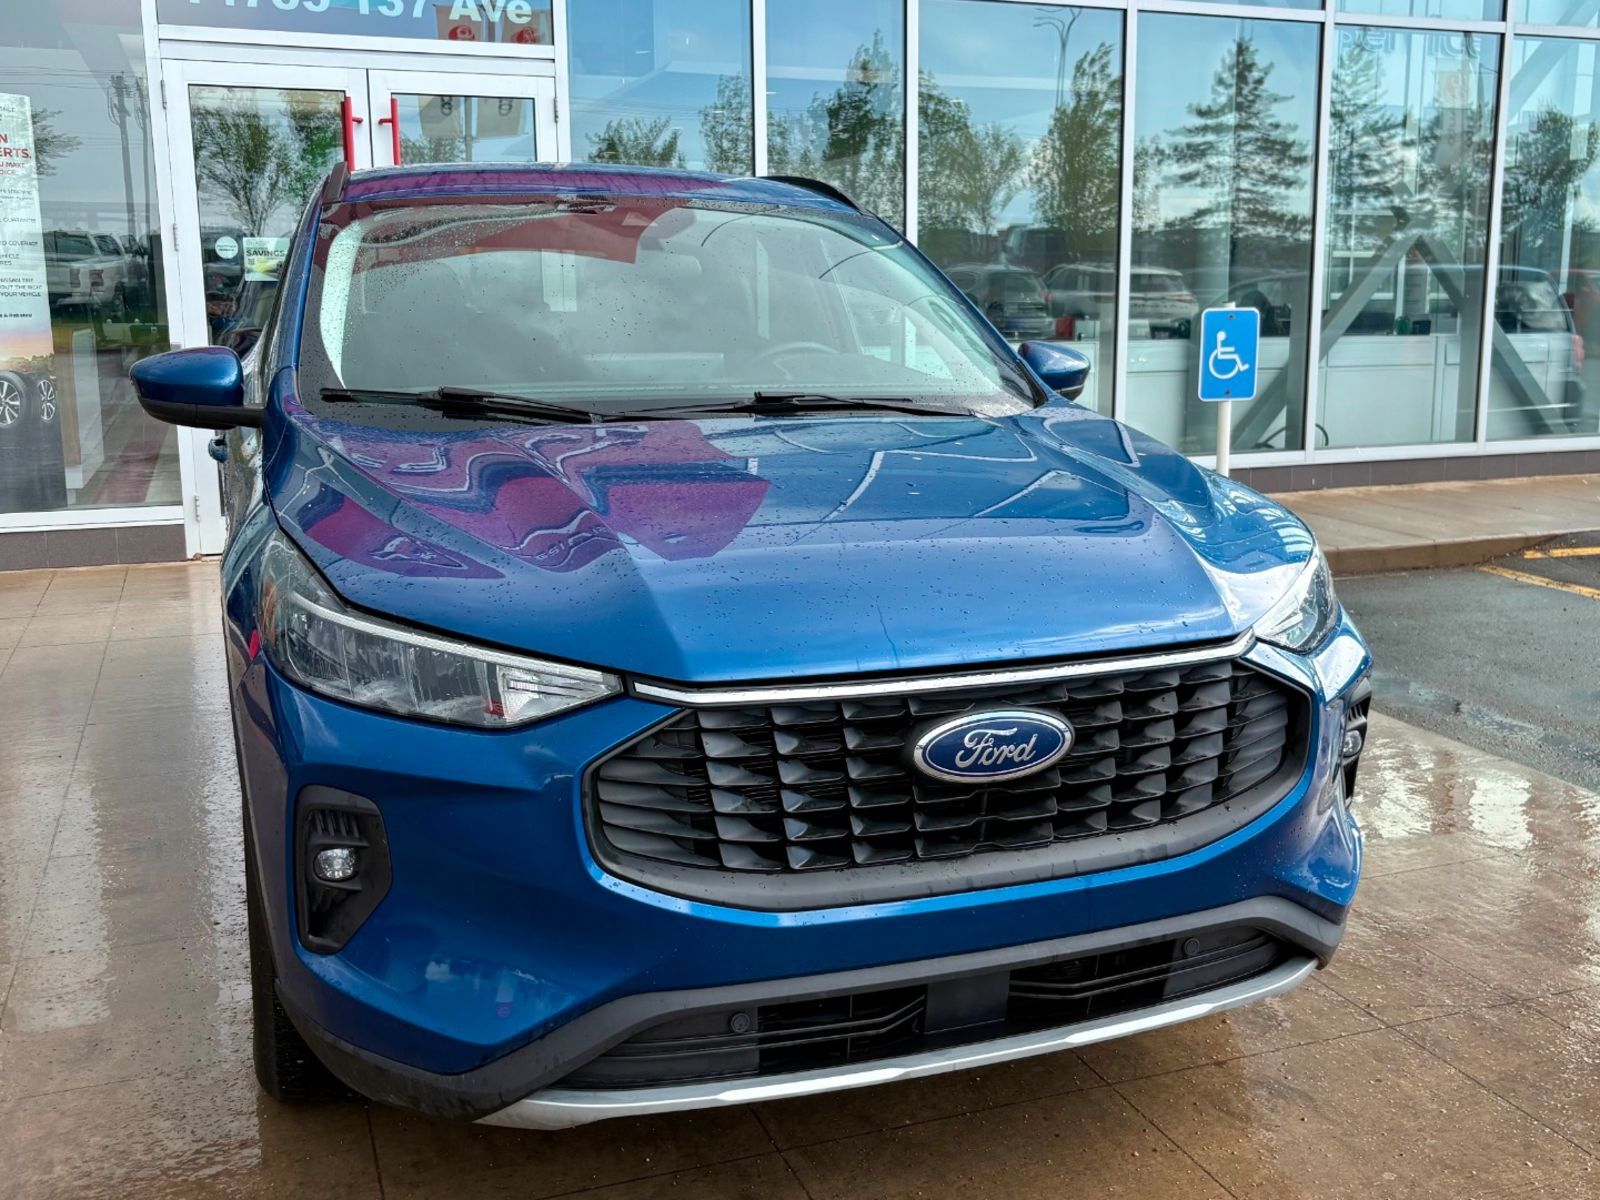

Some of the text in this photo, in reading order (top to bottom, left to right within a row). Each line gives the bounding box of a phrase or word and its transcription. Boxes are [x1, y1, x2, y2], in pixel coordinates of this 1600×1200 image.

[448, 0, 532, 24] Ave
[246, 249, 285, 257] SAVINGS
[955, 727, 1039, 768] Ford
